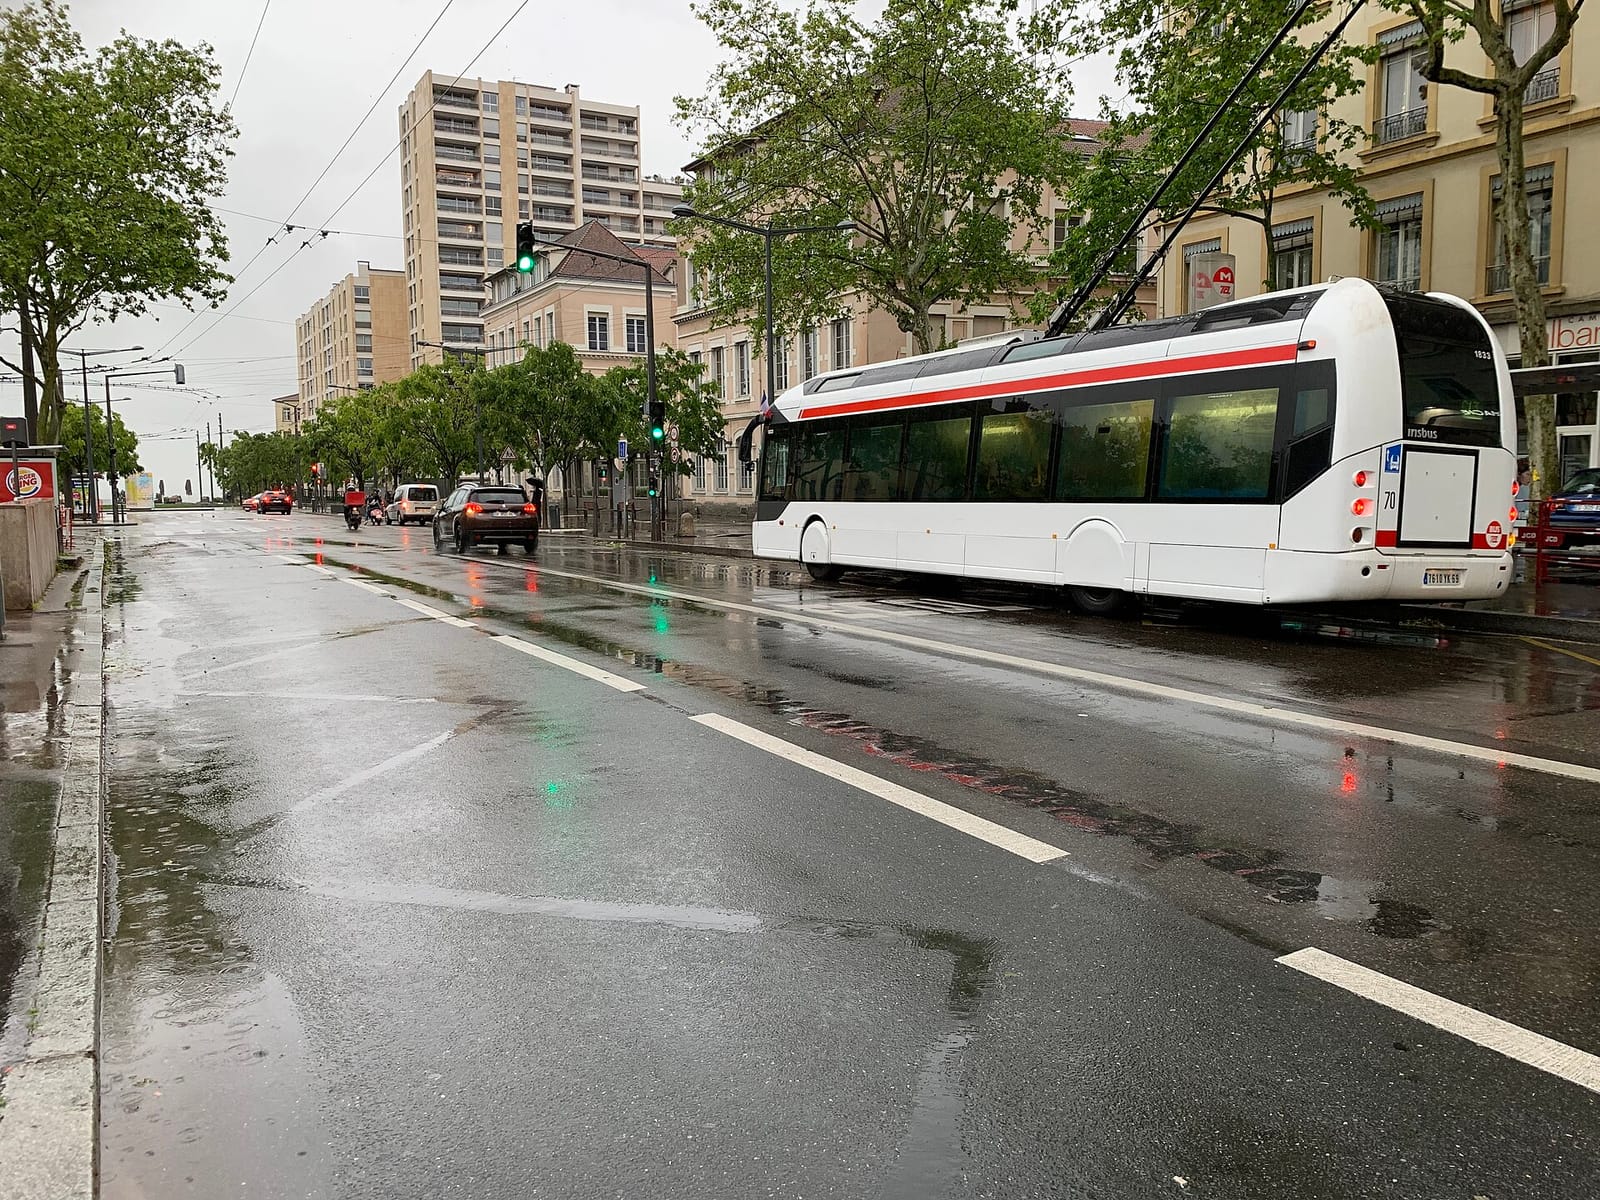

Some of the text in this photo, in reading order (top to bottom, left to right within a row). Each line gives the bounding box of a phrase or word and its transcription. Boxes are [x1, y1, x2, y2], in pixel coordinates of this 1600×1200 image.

[1220, 271, 1231, 281] M
[1474, 350, 1491, 359] 1833
[1384, 491, 1396, 510] 70
